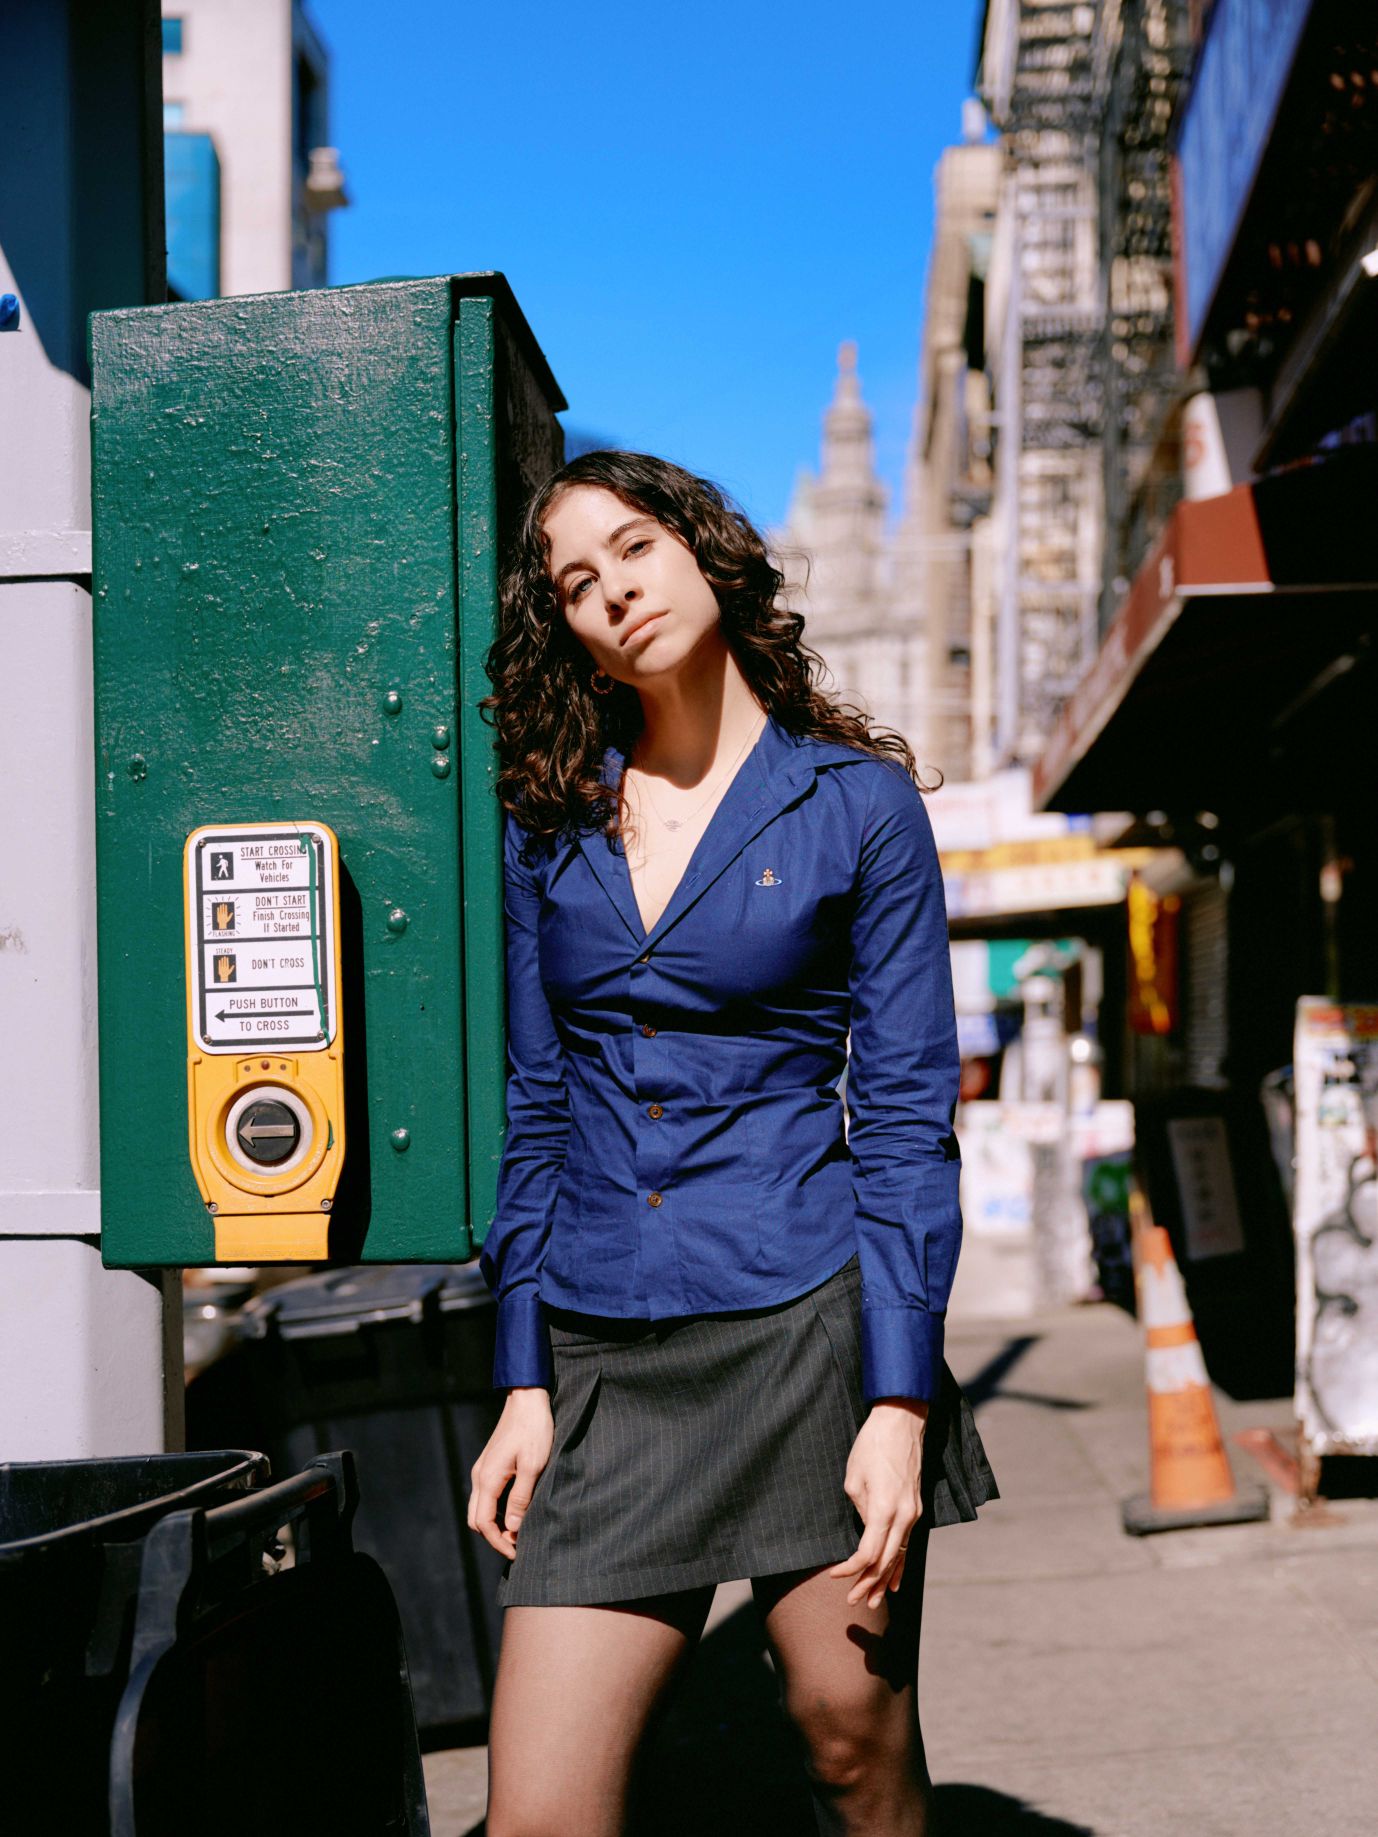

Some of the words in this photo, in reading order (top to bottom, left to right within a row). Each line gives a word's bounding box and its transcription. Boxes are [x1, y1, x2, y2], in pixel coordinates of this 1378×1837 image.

[240, 846, 264, 858] START
[255, 860, 276, 871] Watch
[281, 859, 293, 870] For
[260, 872, 289, 883] Vehicles
[255, 896, 278, 907] DON'T
[283, 895, 306, 905] START
[253, 911, 275, 921] Finish
[279, 910, 310, 922] Crossing
[263, 923, 270, 933] If
[273, 922, 300, 933] Started
[251, 958, 275, 970] DON'T
[279, 957, 305, 969] CROSS
[229, 999, 256, 1010] PUSH
[260, 997, 298, 1009] BUTTON
[240, 1021, 252, 1032] TO
[256, 1020, 290, 1031] CROSS
